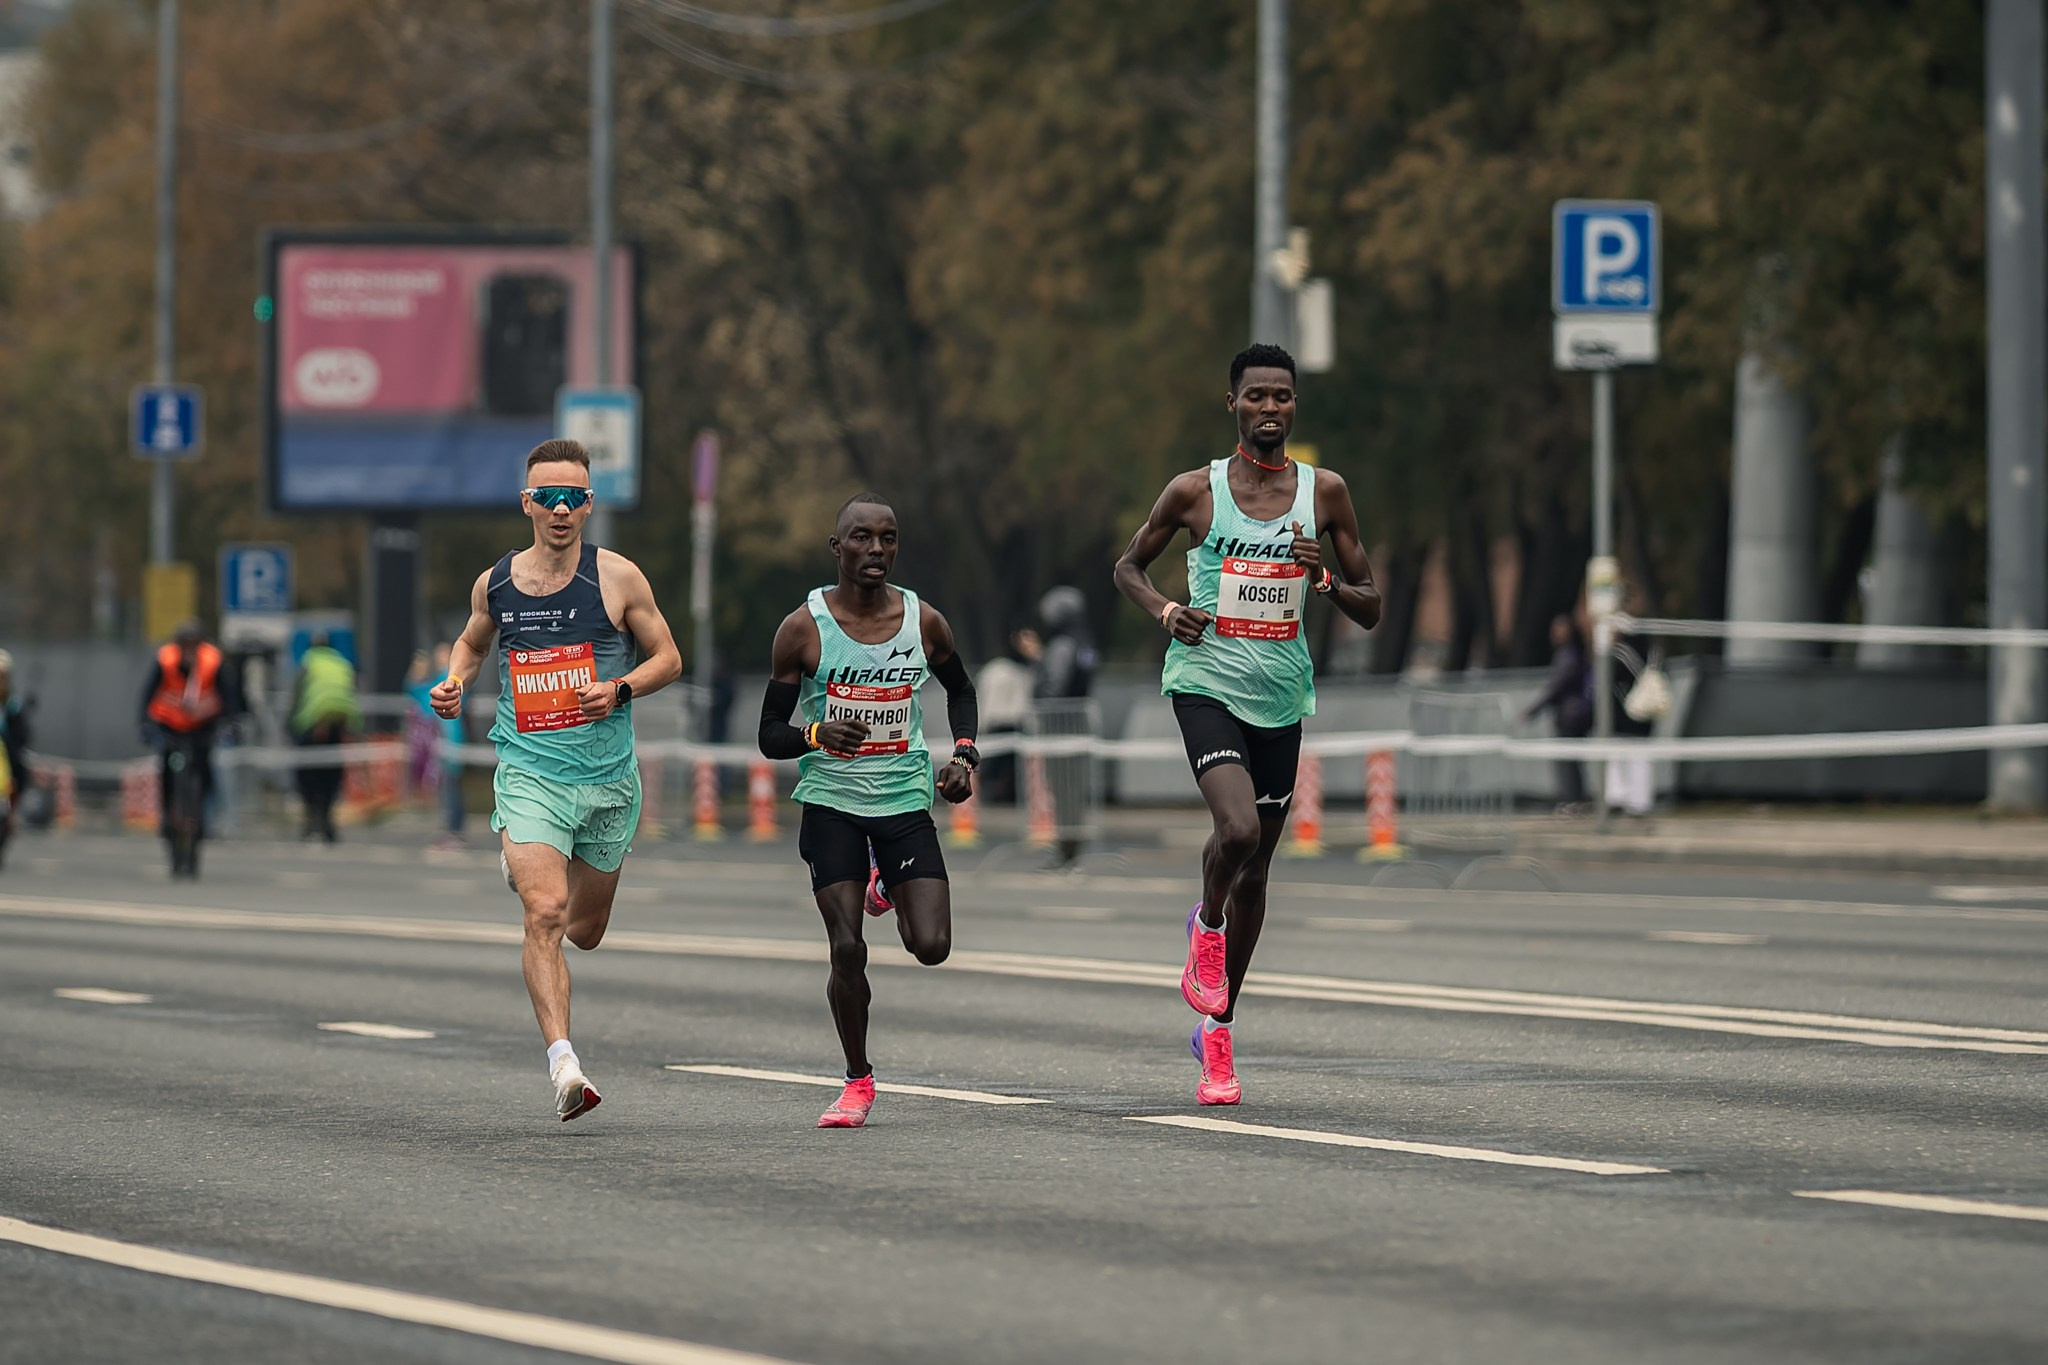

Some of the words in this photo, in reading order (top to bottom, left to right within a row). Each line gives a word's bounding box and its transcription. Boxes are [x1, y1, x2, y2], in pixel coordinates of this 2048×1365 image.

[1583, 216, 1641, 302] P
[1238, 584, 1289, 604] KOSGEI
[516, 667, 592, 694] НИКИТИН
[827, 666, 923, 684] HIRACER
[552, 698, 557, 706] 1
[1197, 750, 1241, 769] HIRACER
